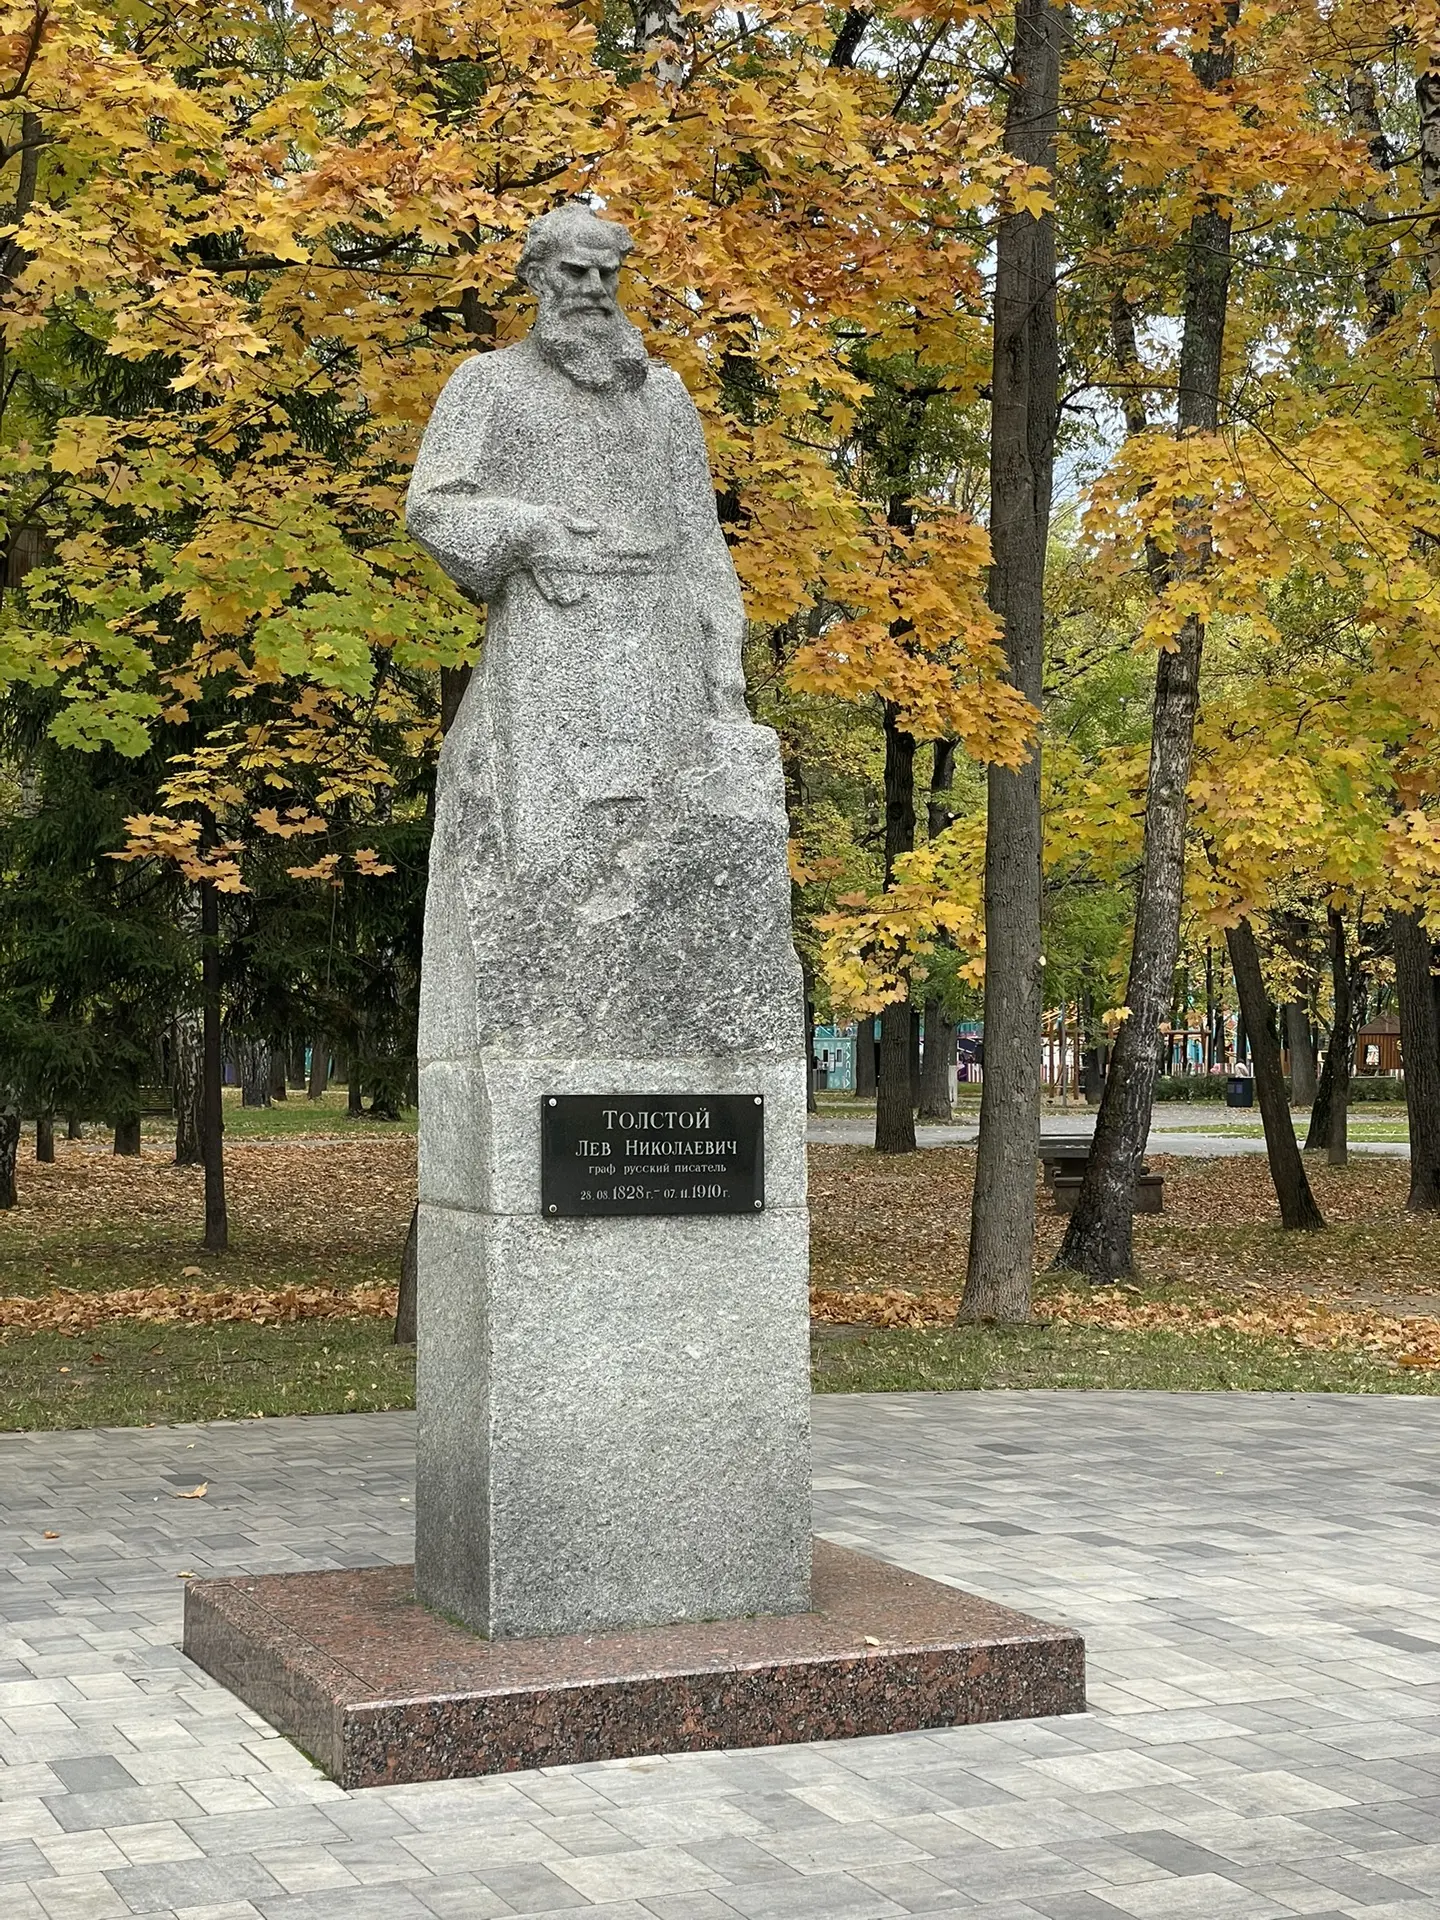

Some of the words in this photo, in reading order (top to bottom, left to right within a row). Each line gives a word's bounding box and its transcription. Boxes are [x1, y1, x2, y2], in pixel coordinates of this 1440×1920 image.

[602, 1107, 711, 1130] ТОЛСТОЙ
[575, 1140, 612, 1157] ЛЕВ
[625, 1139, 738, 1156] НИКОЛАЕВИЧ
[588, 1163, 616, 1175] граф
[623, 1163, 670, 1175] русский
[674, 1163, 727, 1173] писатель
